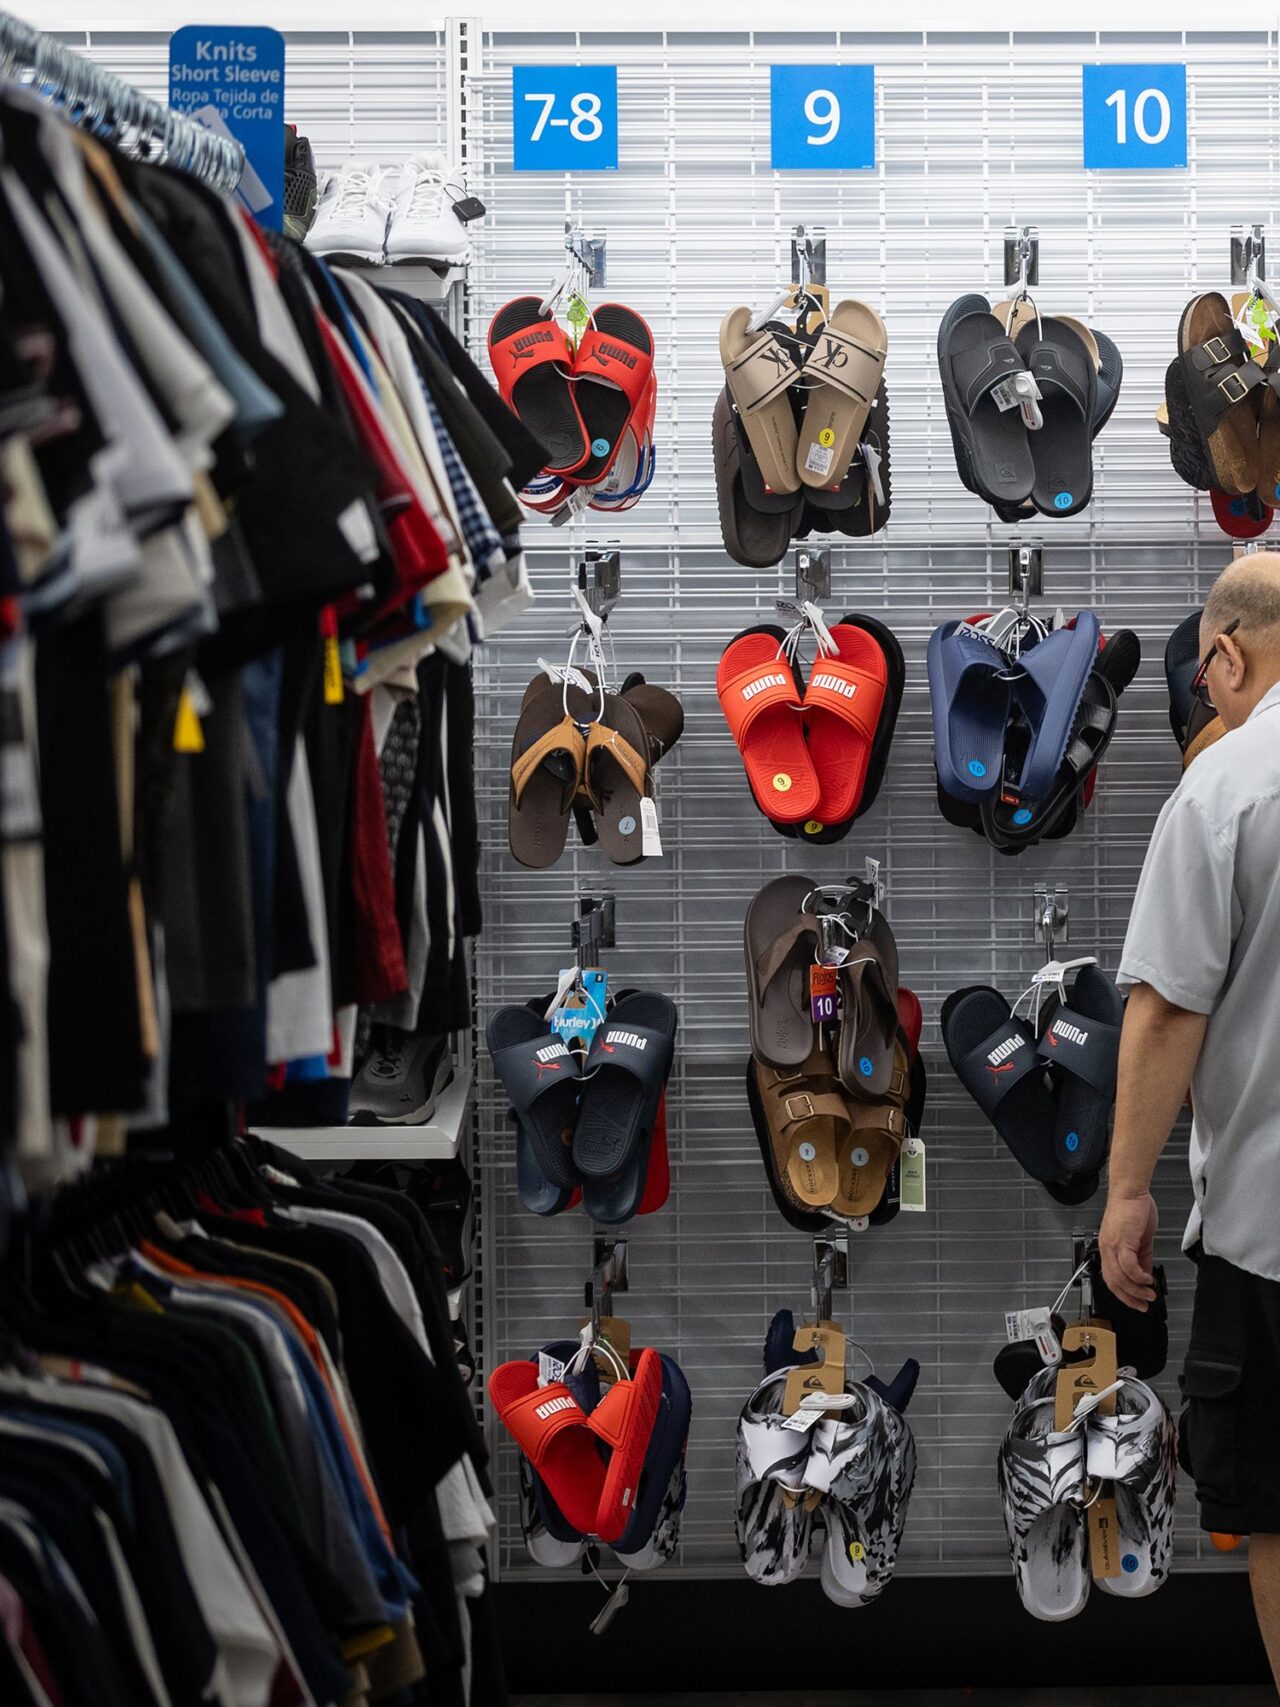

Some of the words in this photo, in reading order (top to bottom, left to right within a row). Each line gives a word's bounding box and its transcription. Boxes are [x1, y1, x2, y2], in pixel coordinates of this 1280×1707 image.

[195, 41, 257, 61] Knits
[172, 64, 219, 81] Short
[225, 64, 280, 82] Sleeve
[172, 87, 209, 104] Ropa
[213, 88, 256, 106] Tejida
[260, 88, 279, 103] de
[233, 104, 273, 119] Corta
[524, 92, 603, 142] 7-8
[804, 89, 840, 145] 9
[1104, 88, 1171, 144] 10
[513, 331, 554, 352] PUMA
[814, 337, 849, 370] CK
[598, 343, 638, 370] PUMA
[824, 432, 831, 441] 9
[1057, 496, 1070, 505] 10
[741, 673, 787, 700] PUMA
[811, 674, 857, 699] PUMA
[817, 997, 832, 1015] 10
[606, 1031, 648, 1050] PUMA
[1052, 1019, 1089, 1047] PUMA
[986, 1033, 1026, 1066] PUMA
[535, 1396, 577, 1420] PUMA
